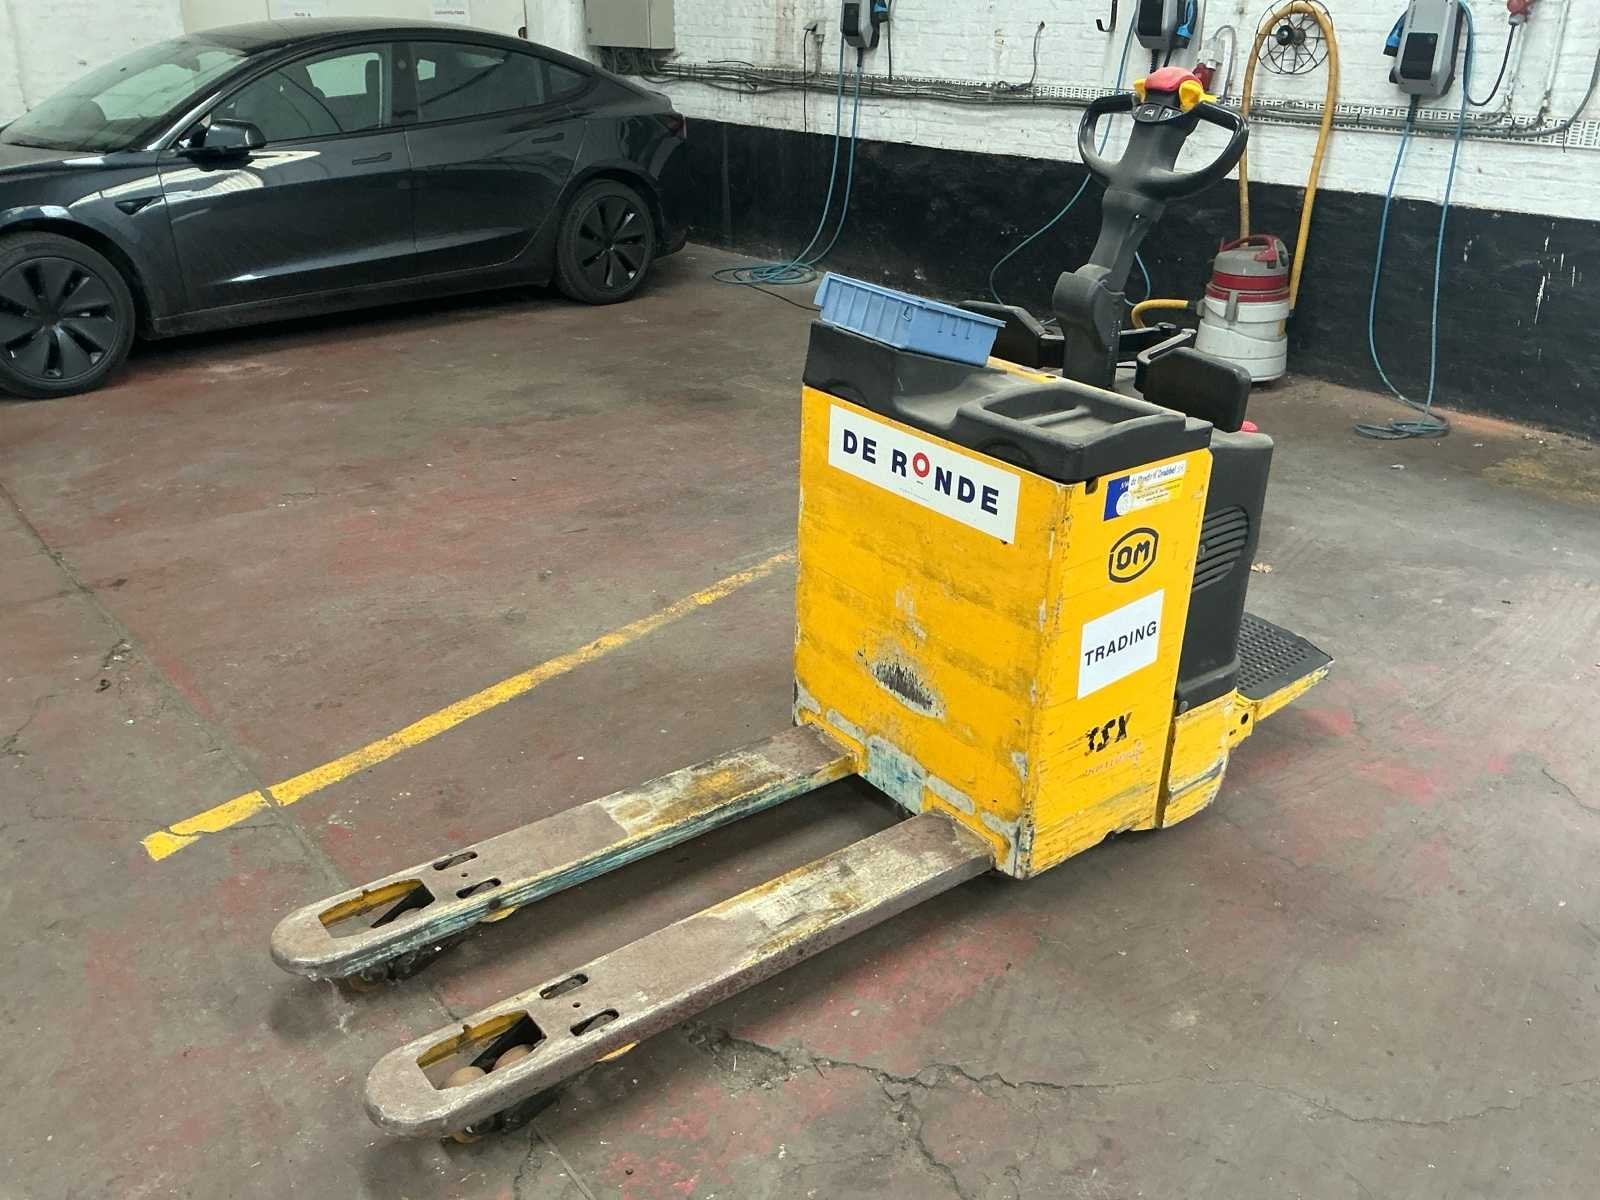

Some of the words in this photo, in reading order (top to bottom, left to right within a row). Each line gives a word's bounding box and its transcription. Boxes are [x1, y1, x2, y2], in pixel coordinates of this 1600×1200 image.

[843, 428, 877, 465] DE
[891, 448, 999, 515] RONDE
[1116, 539, 1151, 570] OM
[1084, 620, 1158, 667] TRADING
